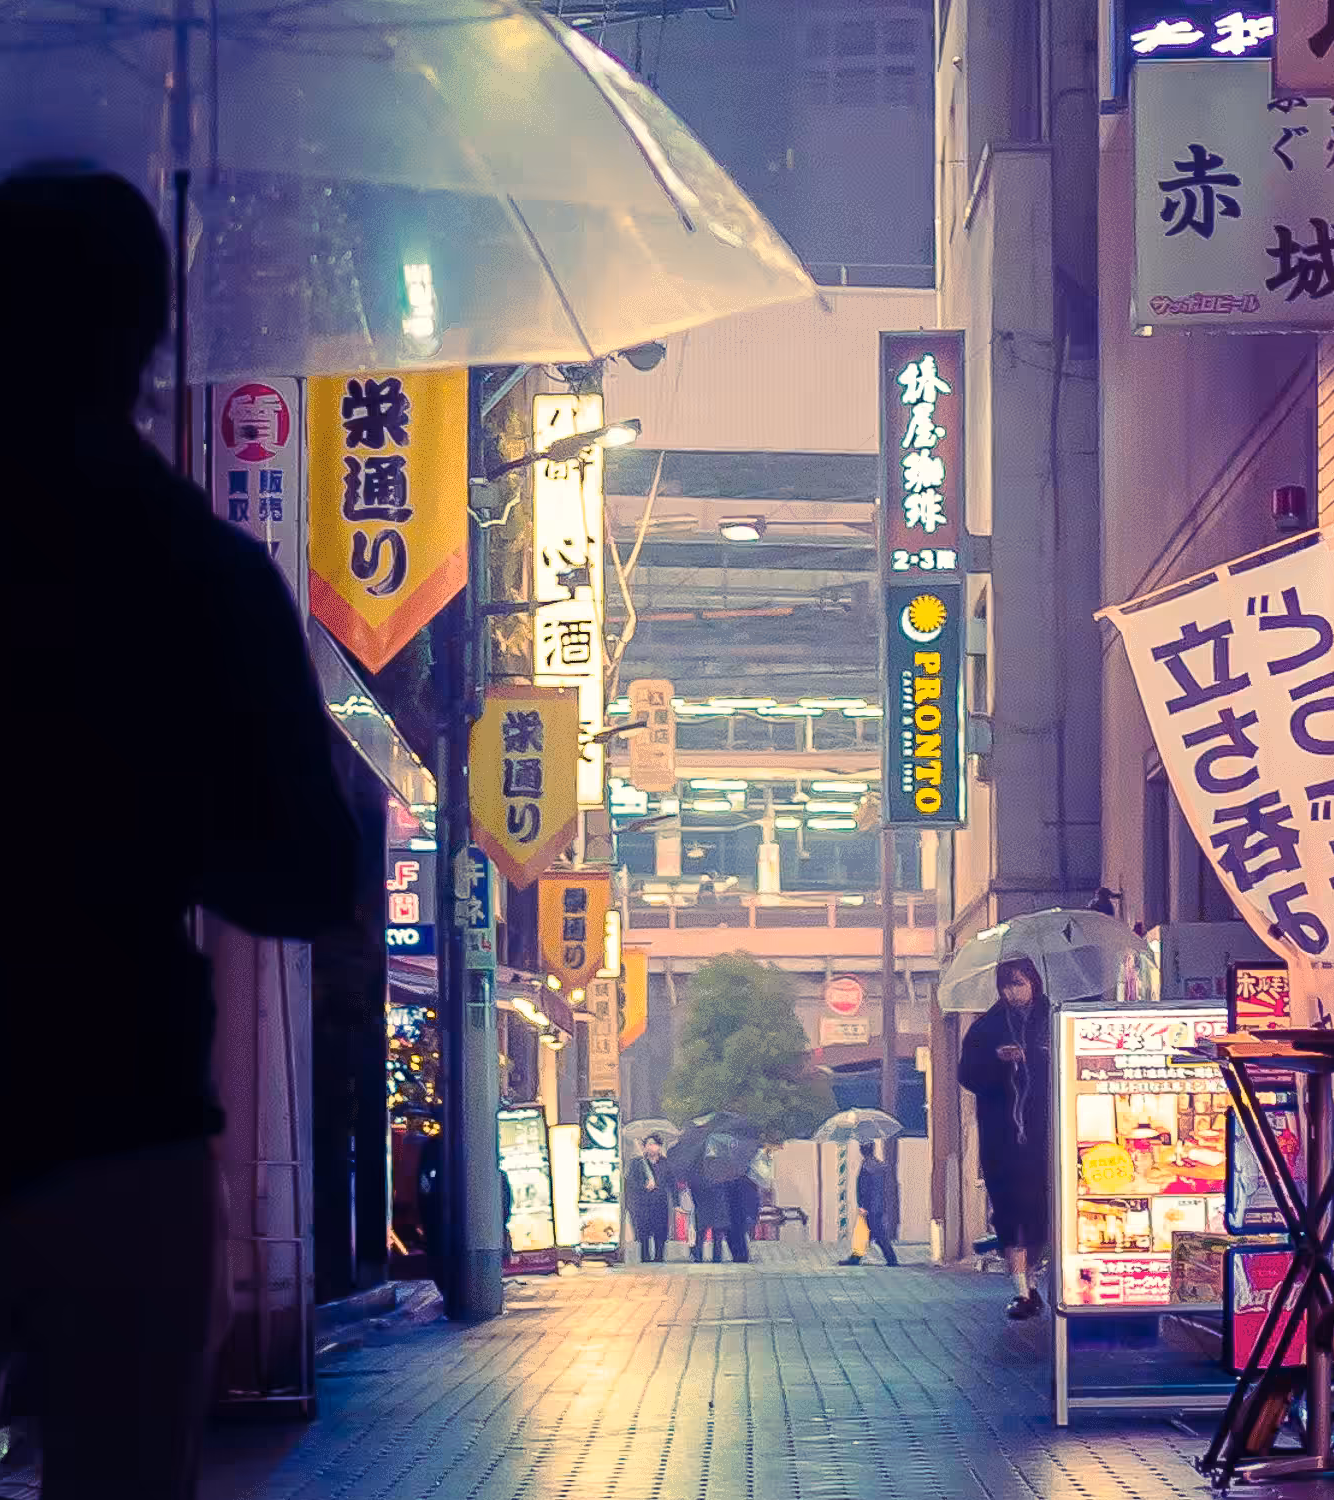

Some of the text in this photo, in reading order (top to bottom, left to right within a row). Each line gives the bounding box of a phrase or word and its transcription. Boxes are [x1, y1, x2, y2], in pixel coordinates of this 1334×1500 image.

[341, 376, 413, 597] 栄通り
[502, 709, 545, 843] 栄通り
[914, 650, 942, 815] PRONTO
